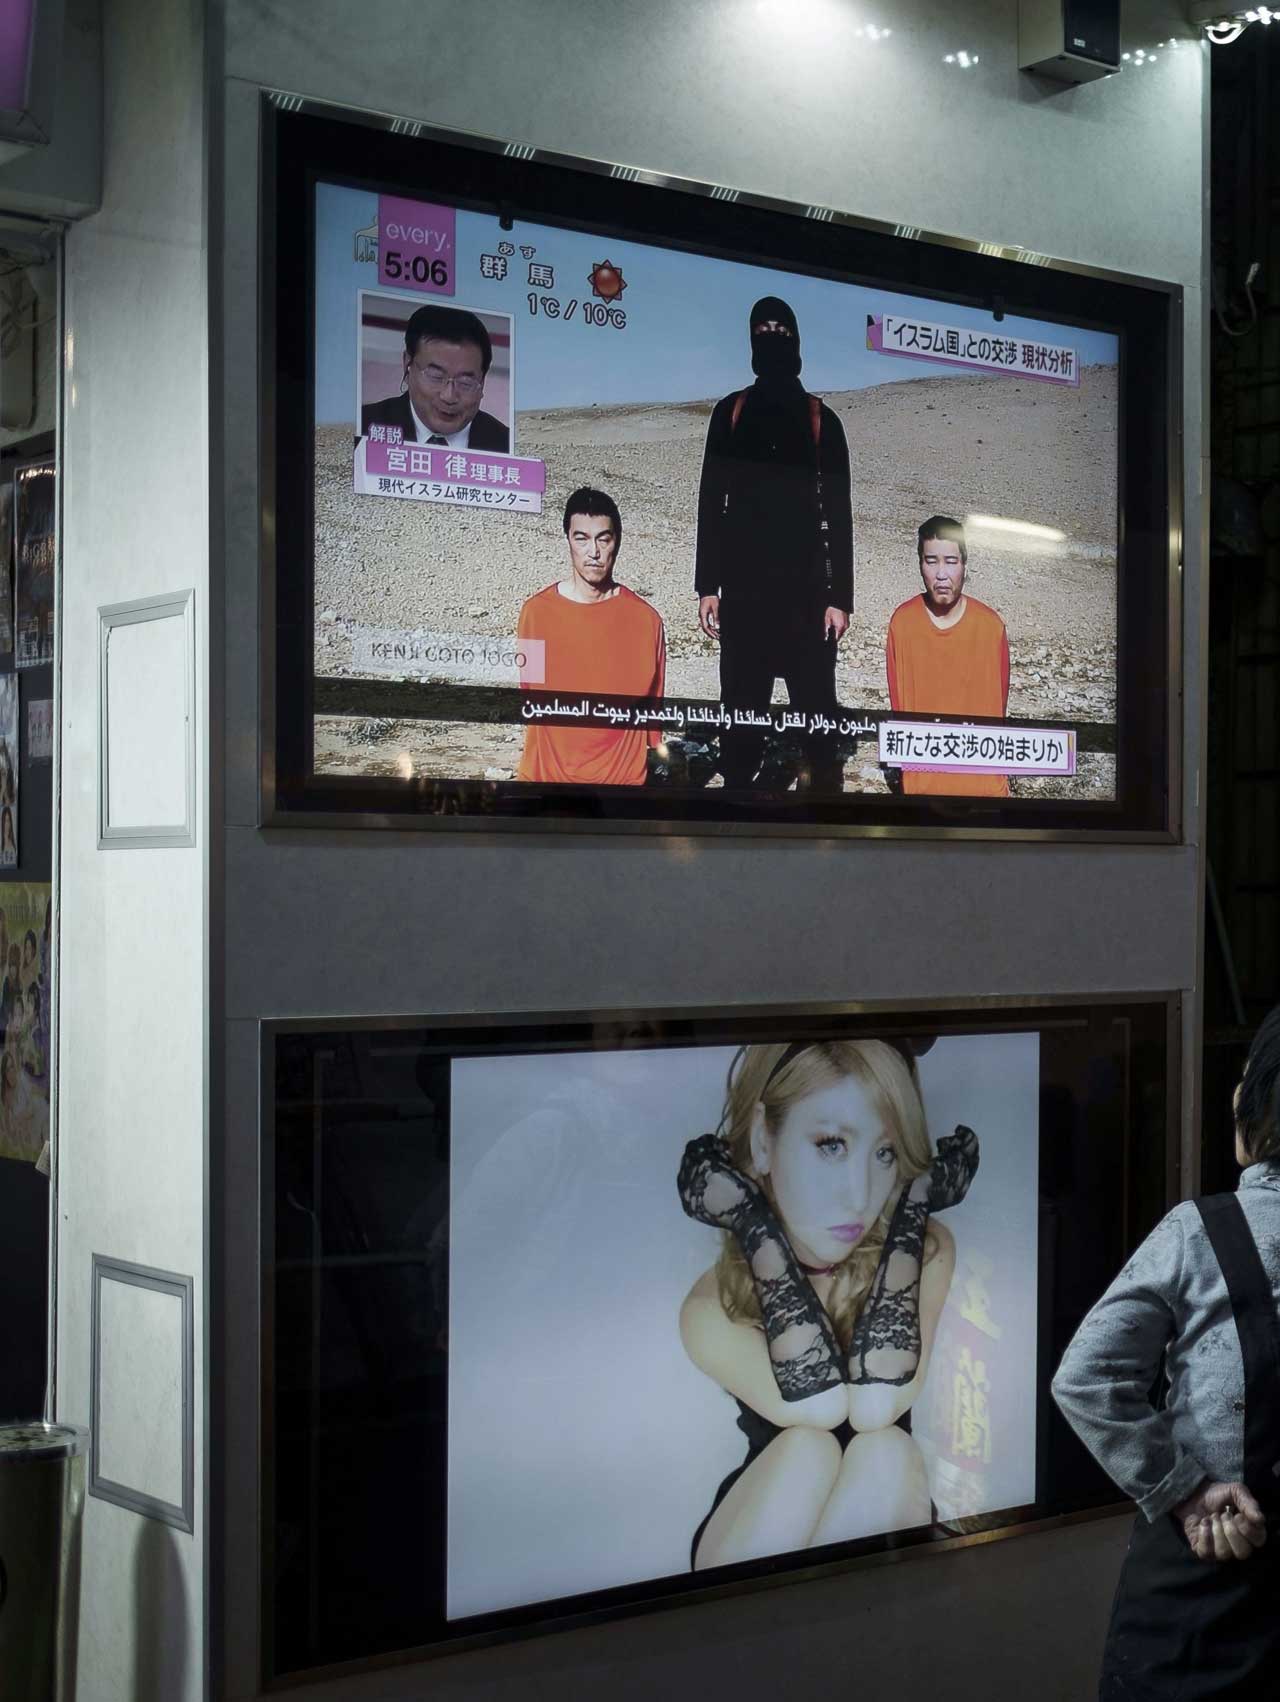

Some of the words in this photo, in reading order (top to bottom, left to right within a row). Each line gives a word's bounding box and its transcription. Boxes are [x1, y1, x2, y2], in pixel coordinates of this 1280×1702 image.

[498, 242, 536, 259] あす
[385, 251, 448, 287] 5:06
[886, 318, 1017, 365] 「イスラム国」との交渉
[1021, 344, 1073, 377] 現状分析
[369, 425, 403, 445] 解説
[386, 447, 432, 475] 宮田
[378, 477, 530, 506] 現代イスラム研究センター
[371, 642, 419, 660] KENJI
[480, 651, 527, 668] JOGO
[521, 699, 589, 718] المسلمين
[592, 703, 631, 724] بيوت
[734, 708, 772, 726] نسائنا
[775, 711, 806, 732] لقتل
[809, 713, 837, 736] دولار
[839, 716, 877, 736] مليون
[886, 729, 1064, 763] 新たな交渉の始まりか
